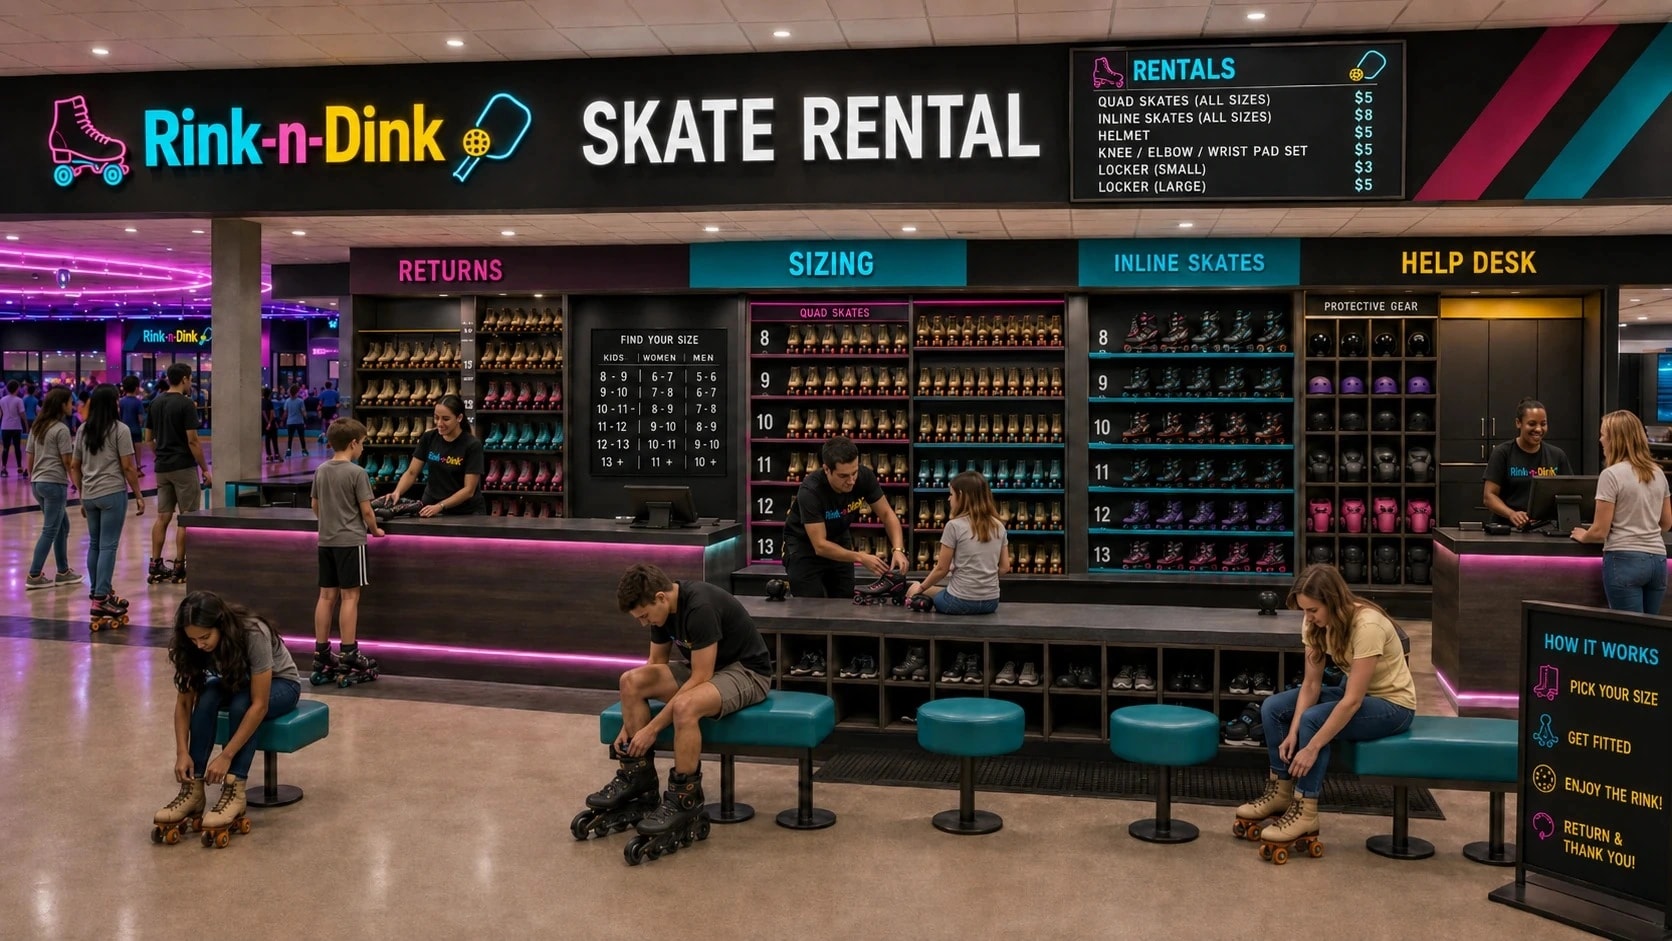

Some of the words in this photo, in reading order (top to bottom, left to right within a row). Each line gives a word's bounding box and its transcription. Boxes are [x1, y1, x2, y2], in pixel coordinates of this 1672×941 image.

[1134, 58, 1235, 80] RENTALS
[1099, 96, 1133, 107] QUAD
[1140, 96, 1188, 106] SKATES
[1195, 95, 1223, 107] (ALL
[1230, 94, 1270, 106] SIZES)
[1355, 90, 1372, 104] $5
[1099, 113, 1140, 124] INLINE
[1145, 113, 1193, 123] SKATES
[1199, 112, 1226, 124] (ALL
[1232, 112, 1271, 124] SIZES)
[1355, 108, 1372, 121] $8
[145, 104, 445, 166] Rink-n-Dink
[583, 98, 774, 165] SKATE
[804, 93, 1040, 160] RENTAL
[1099, 130, 1150, 140] HELMET
[1355, 125, 1372, 139] $5
[1099, 147, 1132, 158] KNEE
[1137, 147, 1142, 158] /
[1148, 147, 1193, 157] ELBOW
[1198, 147, 1203, 157] /
[1208, 146, 1247, 156] WRIST
[1254, 146, 1279, 156] PAD
[1285, 145, 1308, 156] SET
[1355, 143, 1372, 156] $5
[1099, 164, 1148, 175] LOCKER
[1155, 164, 1205, 176] (SMALL)
[1355, 160, 1372, 174] $3
[1099, 181, 1148, 192] LOCKER
[1155, 181, 1205, 193] (LARGE)
[1355, 178, 1372, 192] $5
[789, 251, 873, 275] SIZING
[1115, 254, 1178, 271] INLINE
[1189, 254, 1264, 271] SKATES
[1403, 252, 1463, 273] HELP
[1474, 251, 1536, 273] DESK
[400, 259, 502, 281] RETURNS
[800, 308, 827, 318] QUAD
[833, 308, 869, 317] SKATES
[1325, 302, 1385, 311] PROTECTIVE
[1391, 302, 1417, 310] GEAR
[143, 330, 198, 342] Rink-n-Dink
[621, 335, 643, 344] FIND
[648, 336, 673, 344] YOUR
[678, 335, 698, 344] SIZE
[761, 330, 769, 346] 8
[1099, 330, 1107, 345] 8
[761, 372, 769, 388] 9
[1099, 375, 1107, 390] 9
[757, 414, 772, 429] 10
[1095, 419, 1110, 435] 10
[758, 457, 770, 472] 11
[1096, 464, 1108, 480] 11
[758, 498, 773, 513] 12
[1095, 506, 1110, 522] 12
[758, 539, 773, 554] 13
[1094, 547, 1110, 562] 13
[1545, 634, 1578, 652] HOW
[1584, 639, 1597, 655] IT
[1602, 642, 1658, 665] WORKS
[1571, 680, 1595, 696] PICK
[1599, 684, 1629, 701] YOUR
[1633, 690, 1658, 706] SIZE
[1568, 731, 1589, 746] GET
[1594, 735, 1631, 754] FITTED
[1565, 777, 1601, 796] ENJOY
[1605, 786, 1626, 802] THE
[1632, 791, 1662, 810] RINK!
[1564, 820, 1609, 845] RETURN
[1615, 832, 1622, 846] &
[1564, 839, 1604, 861] THANK
[1608, 850, 1634, 869] YOU!
